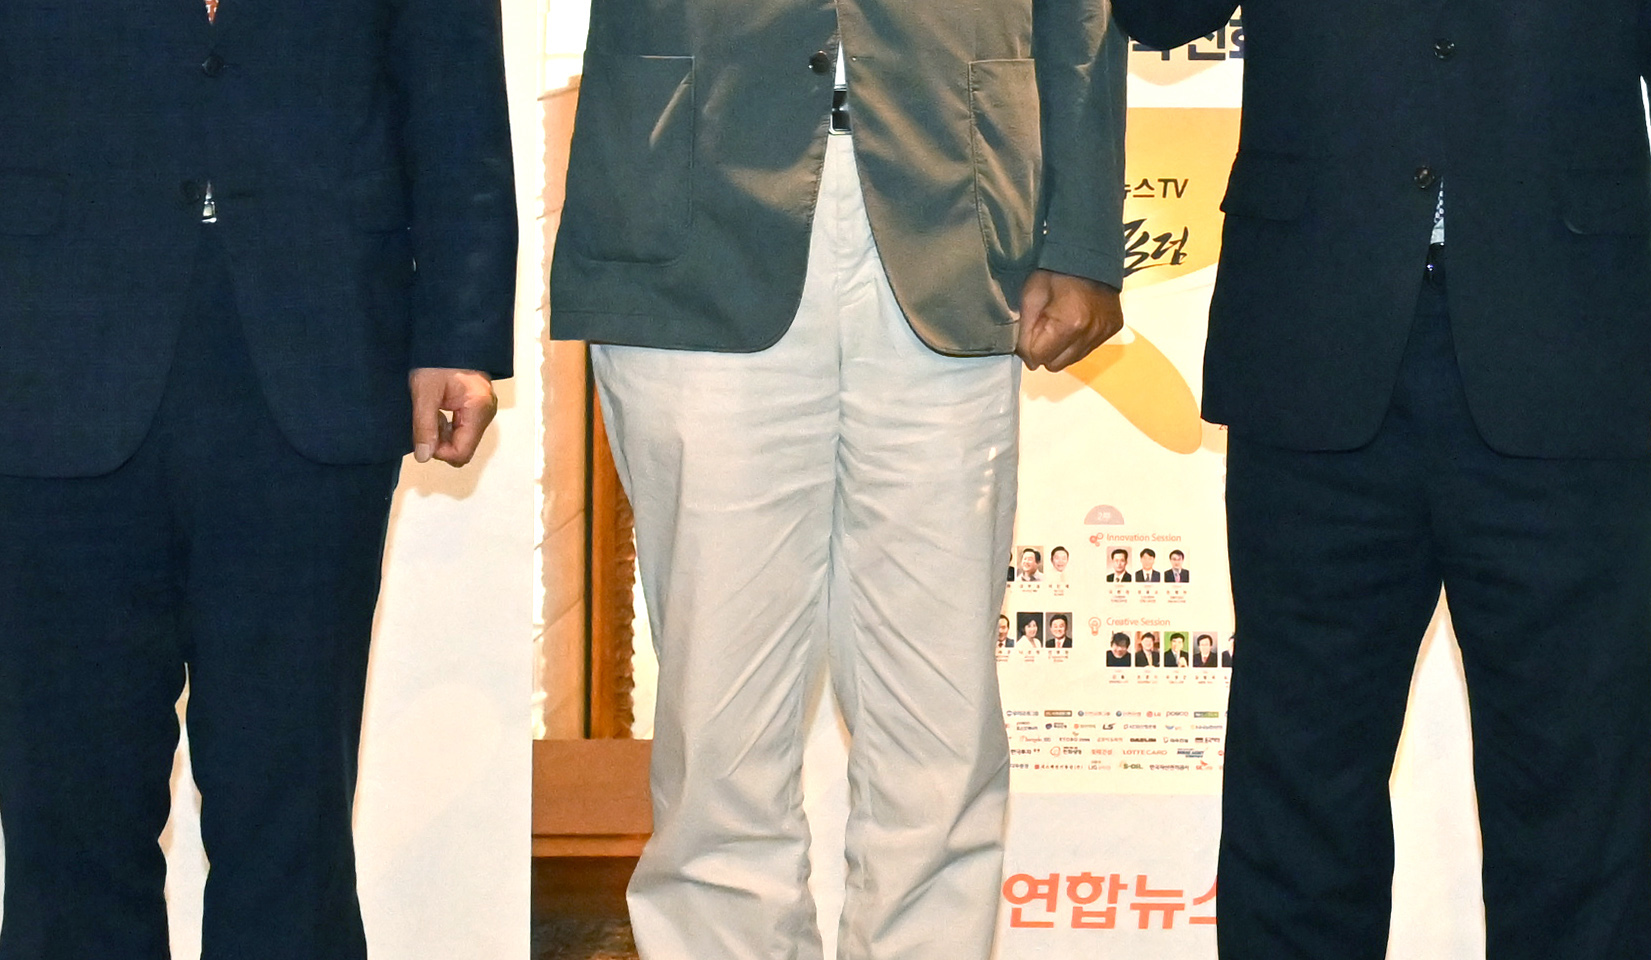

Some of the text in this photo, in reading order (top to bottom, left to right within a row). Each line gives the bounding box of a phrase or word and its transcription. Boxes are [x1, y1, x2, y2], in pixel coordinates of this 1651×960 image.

[1106, 533, 1182, 542] Innovation Session
[1106, 617, 1171, 627] Creative Session
